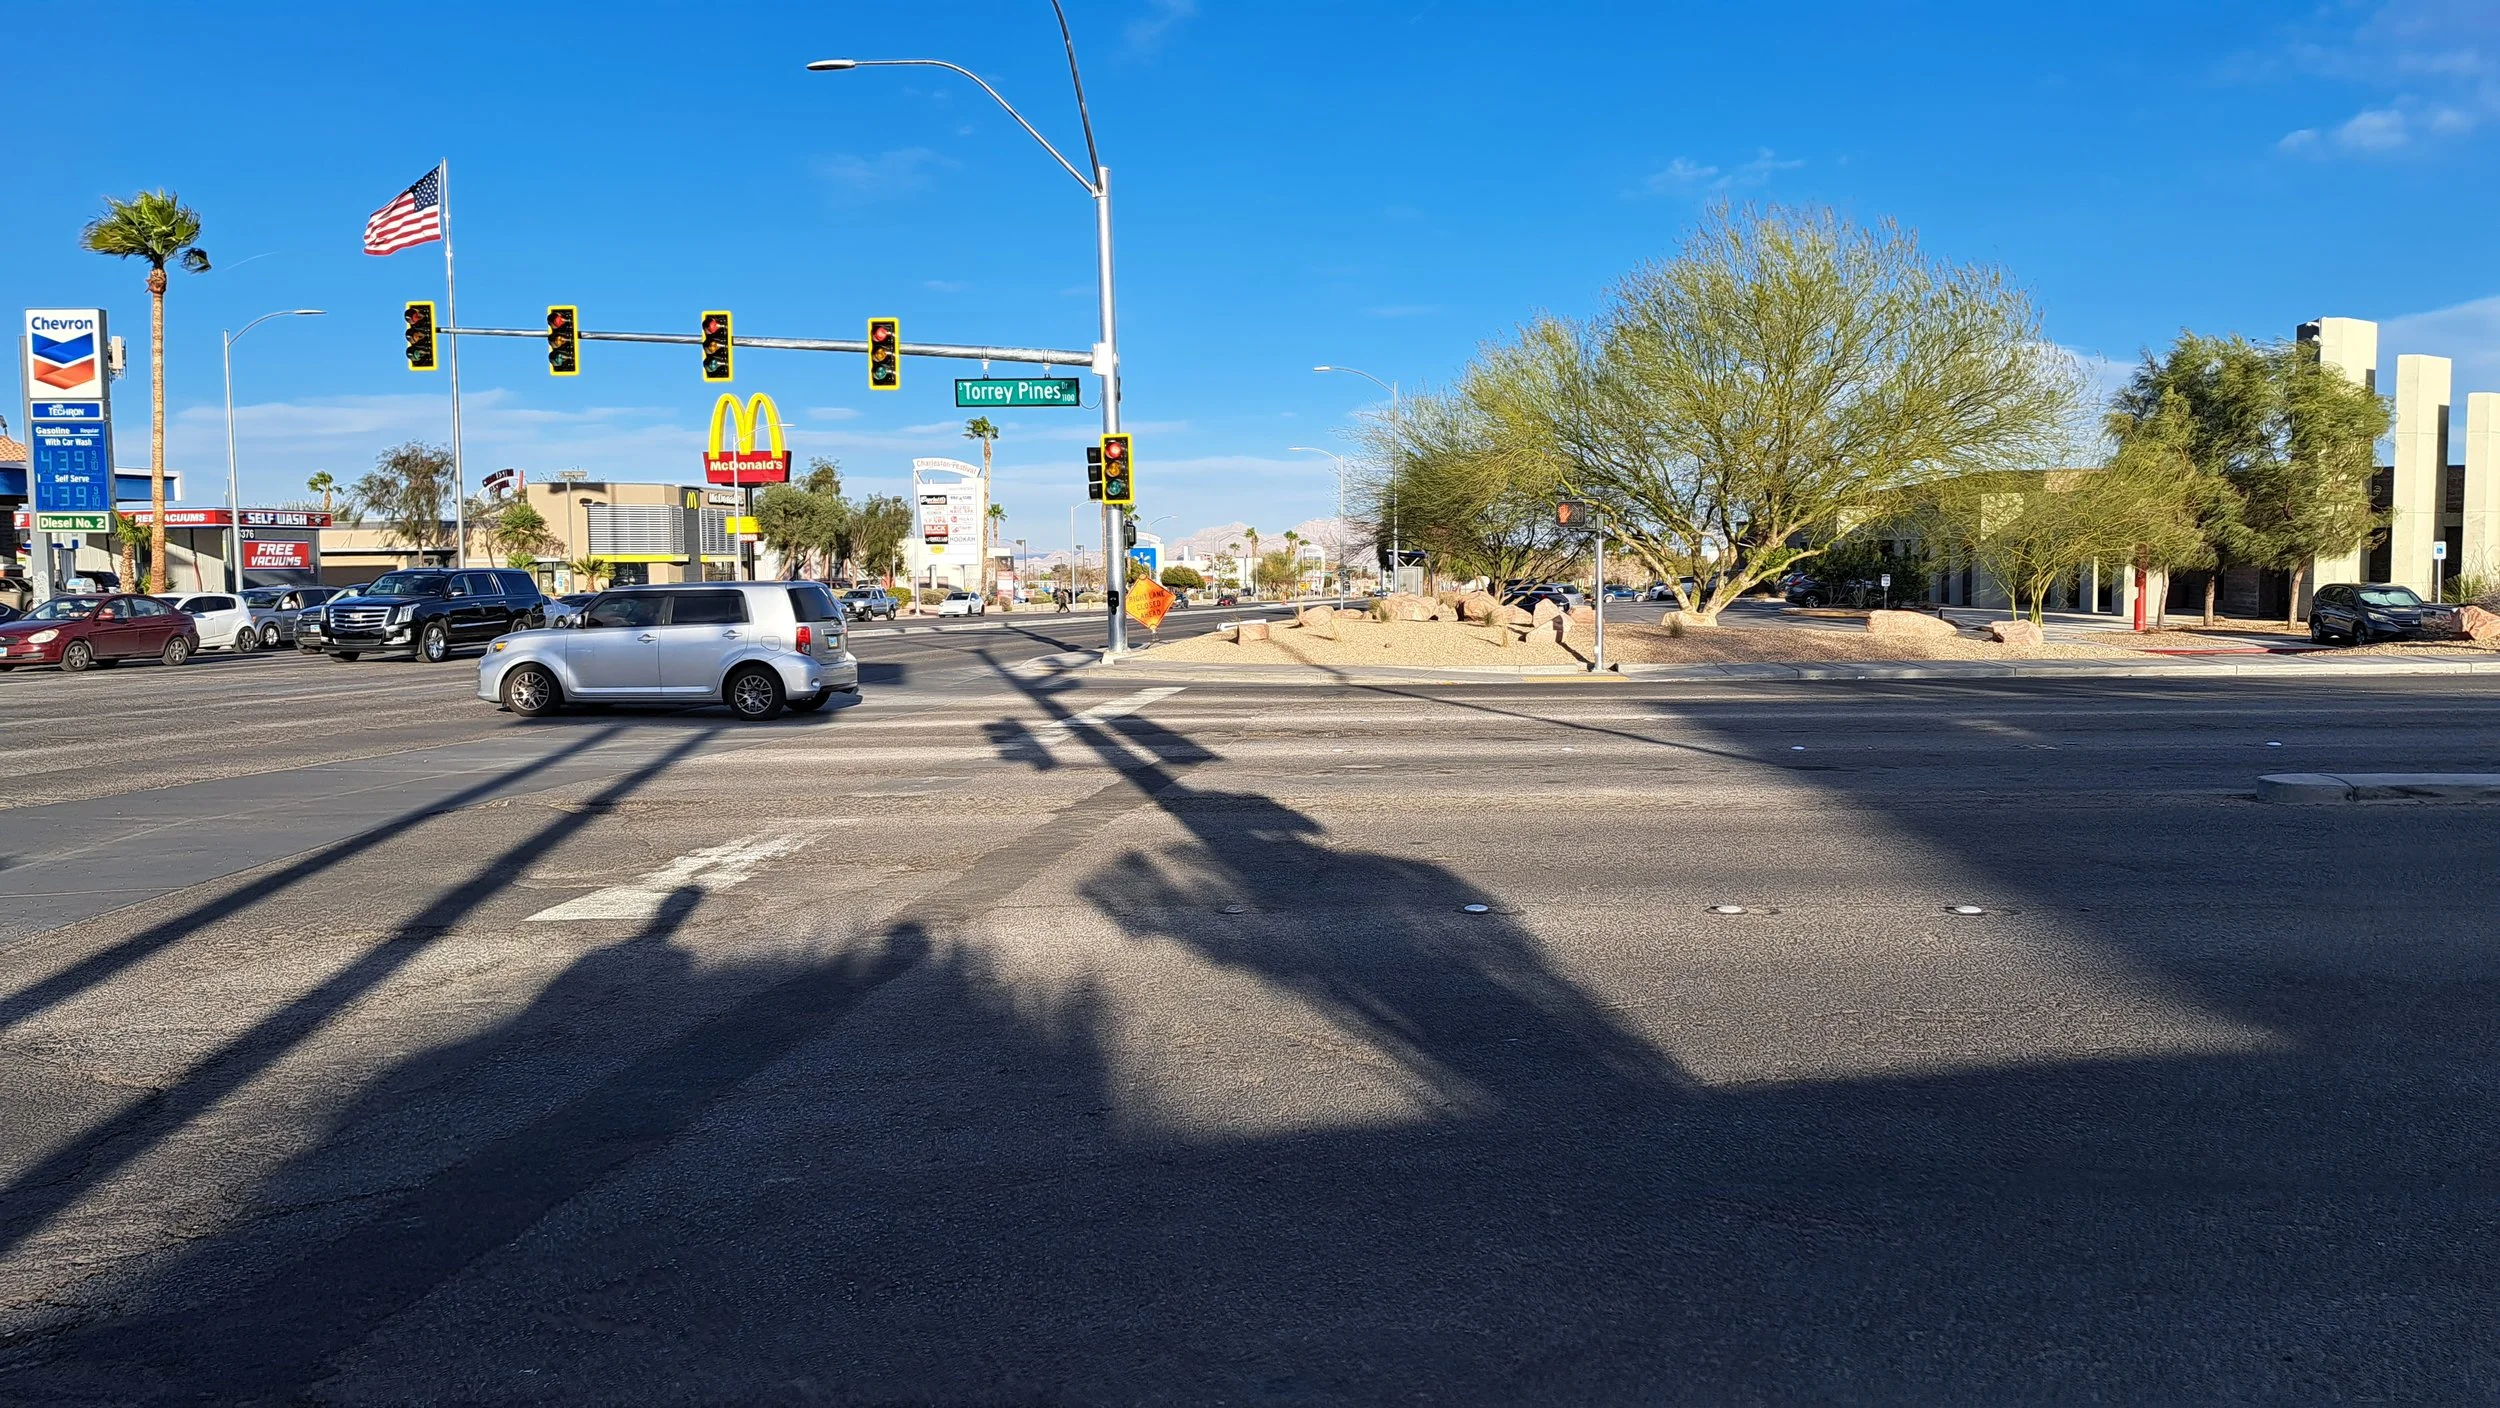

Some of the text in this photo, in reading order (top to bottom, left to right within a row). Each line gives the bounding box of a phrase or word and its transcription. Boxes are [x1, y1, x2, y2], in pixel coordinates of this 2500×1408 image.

[31, 316, 93, 330] Chevron
[958, 381, 1069, 404] S Torrey Pines Dr
[48, 407, 85, 417] TECHRON
[45, 438, 92, 446] With Car Wash
[55, 475, 90, 483] Self Serve
[708, 493, 744, 505] McDonal's
[41, 518, 105, 528] Diesel No. 2
[164, 513, 206, 522] ACUUMS
[248, 513, 308, 525] SELF WASH
[256, 543, 296, 556] FREE
[250, 556, 302, 567] VACUUMS
